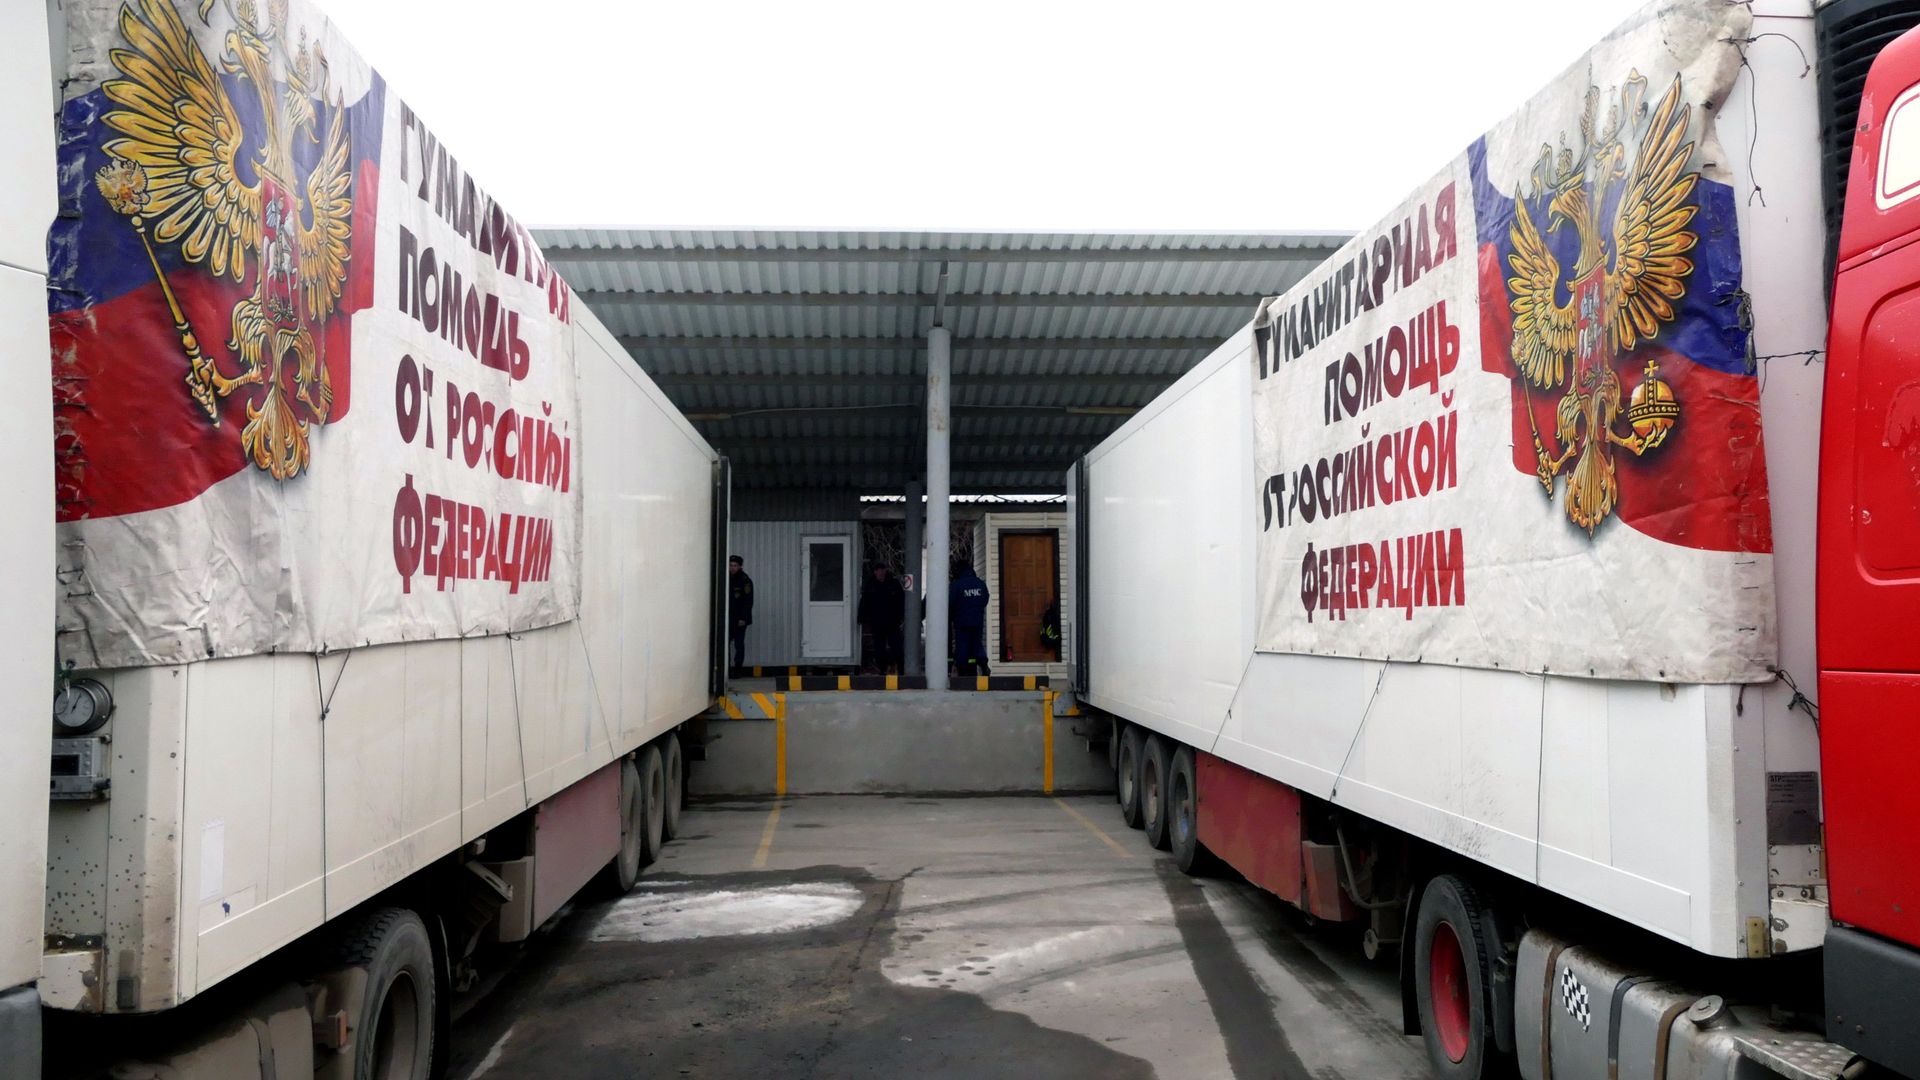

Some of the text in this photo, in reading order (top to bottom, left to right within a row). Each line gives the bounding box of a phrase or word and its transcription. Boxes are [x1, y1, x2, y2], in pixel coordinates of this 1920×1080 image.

[400, 99, 570, 325] ГУМАИТАЯ
[399, 224, 530, 386] ПОМОЩЬ
[1255, 182, 1457, 379] ГУМАНИТАРНАЯ
[395, 354, 434, 449] ОТ
[1325, 299, 1460, 425] ПОМОЩЬ
[393, 473, 552, 594] ФЕДЕРАЦИИ
[964, 588, 982, 597] МЧС
[1301, 528, 1465, 623] ФЕДЕРАЦИИ
